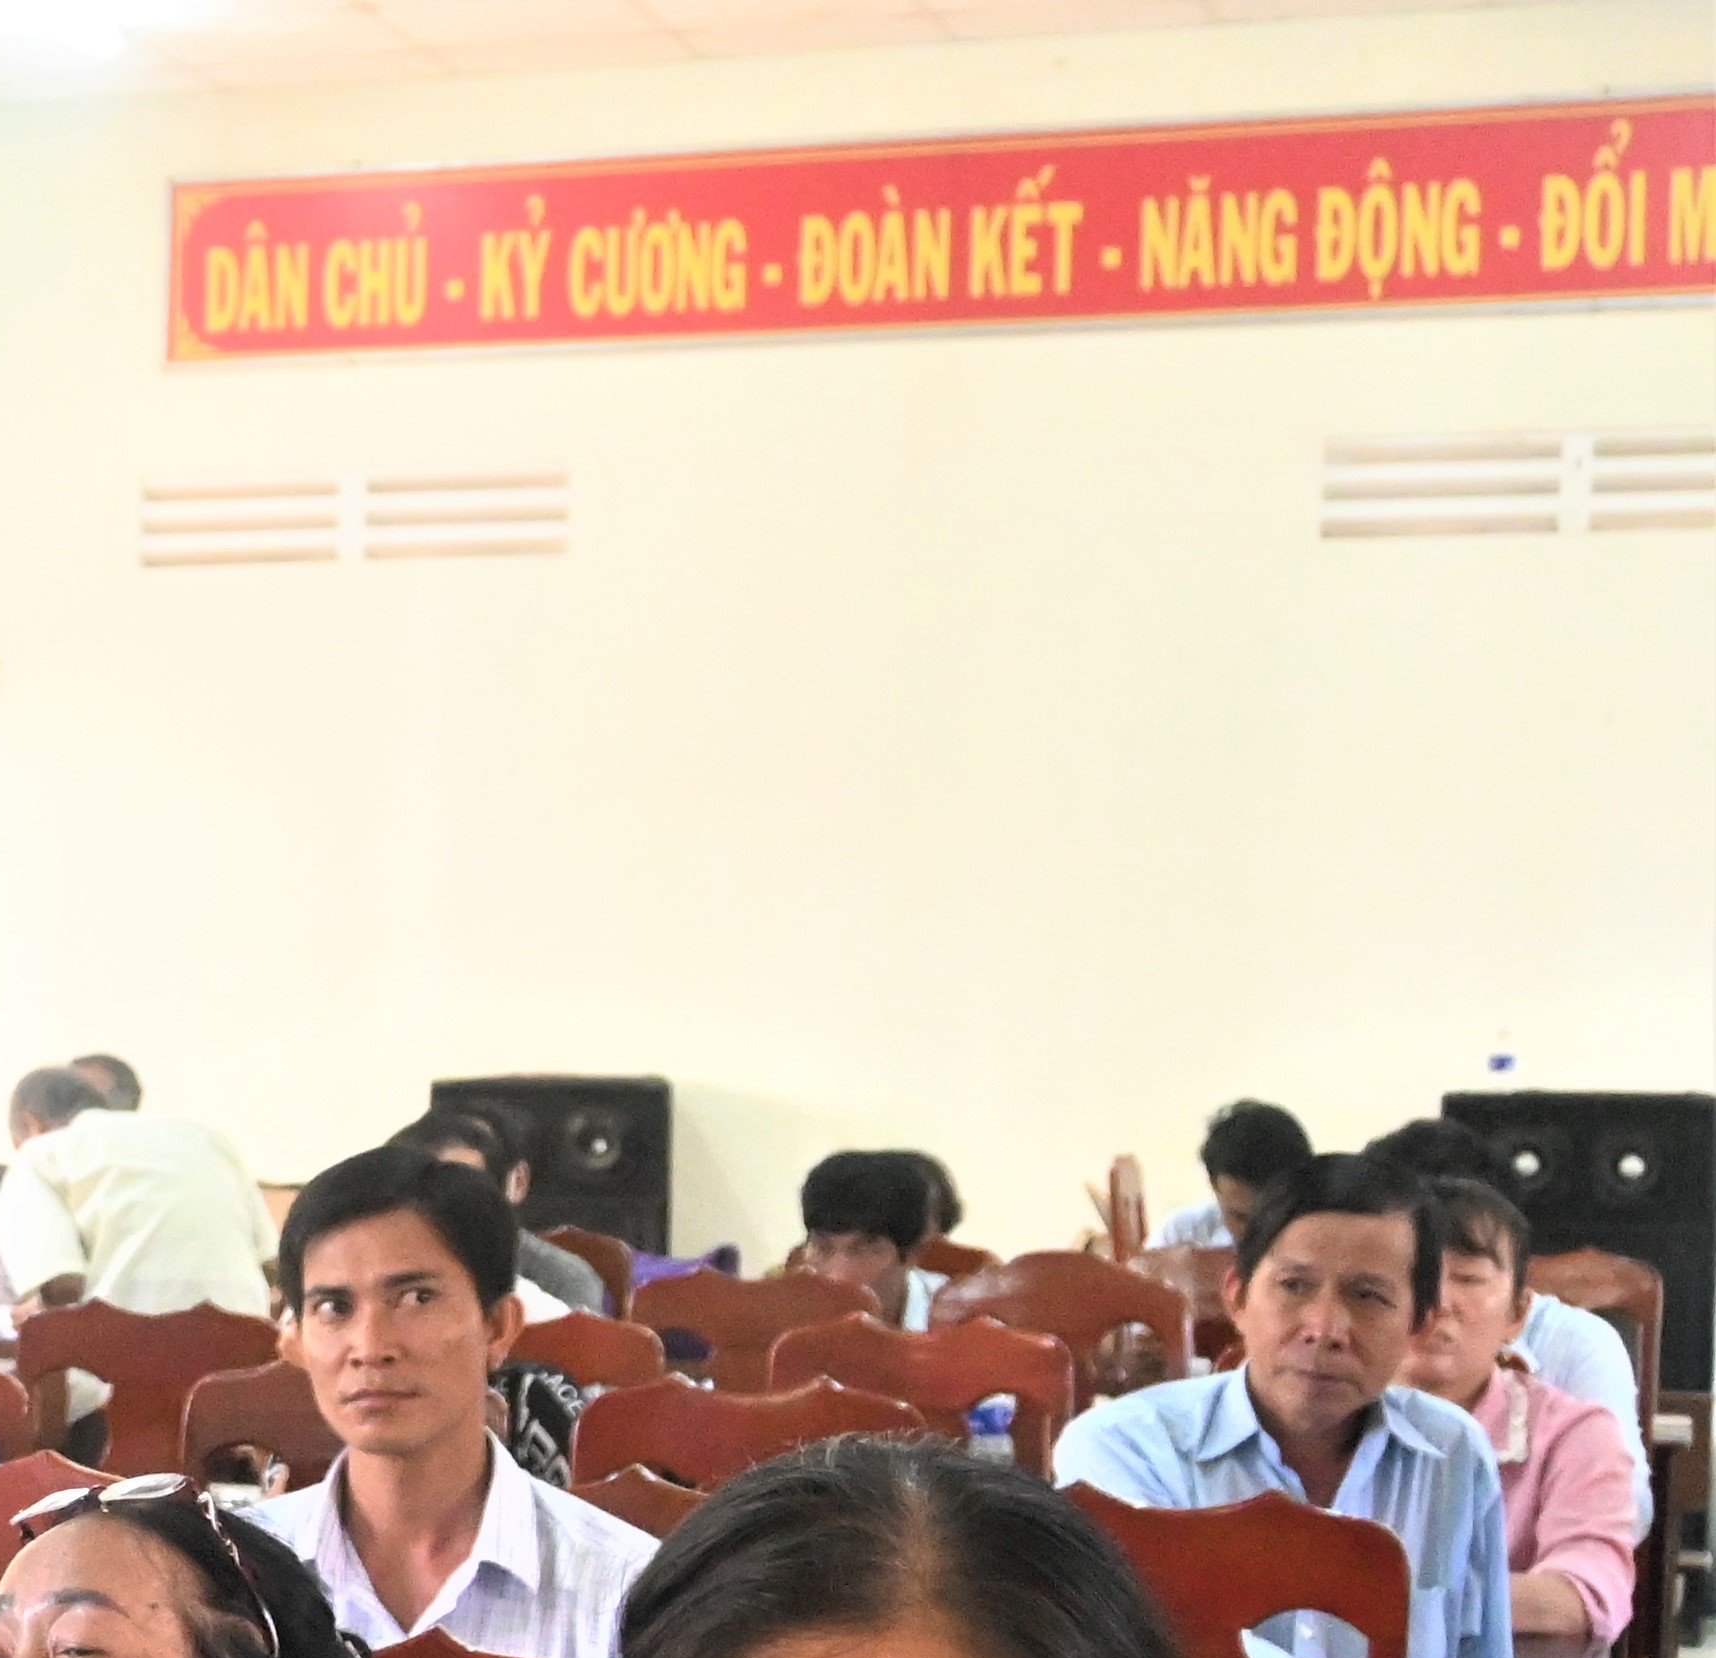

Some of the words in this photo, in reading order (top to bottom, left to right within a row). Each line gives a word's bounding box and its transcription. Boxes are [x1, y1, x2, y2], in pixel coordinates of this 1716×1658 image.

[204, 220, 309, 333] DÂN
[323, 201, 428, 329] CHỦ
[479, 194, 552, 320] KỶ
[568, 205, 747, 318] CƯƠNG
[798, 184, 952, 308] ĐOÀN
[969, 163, 1084, 298] KẾT
[1139, 174, 1299, 293] NĂNG
[1314, 156, 1482, 301] ĐỘNG
[1540, 117, 1647, 273] ĐỔI
